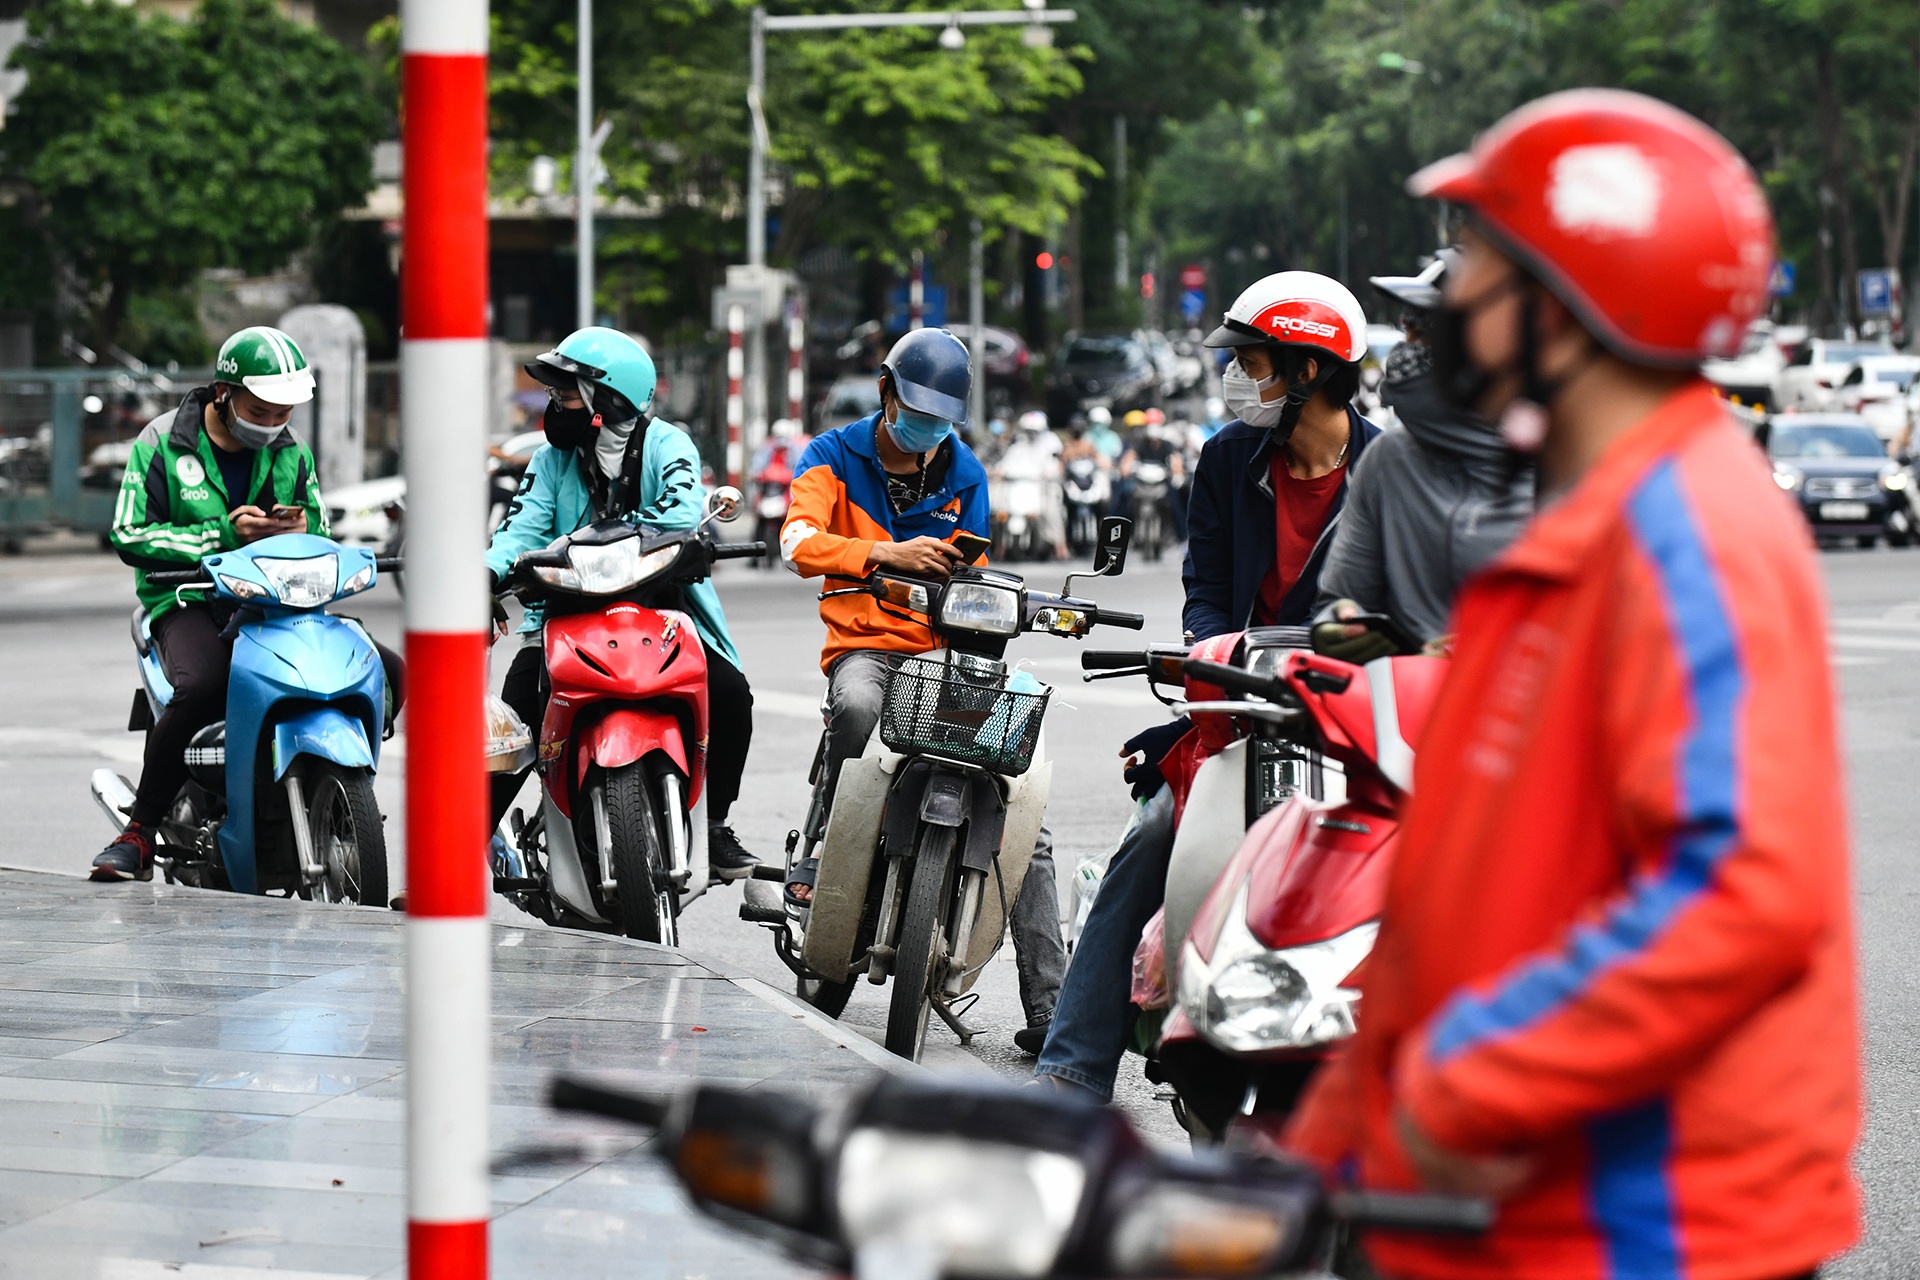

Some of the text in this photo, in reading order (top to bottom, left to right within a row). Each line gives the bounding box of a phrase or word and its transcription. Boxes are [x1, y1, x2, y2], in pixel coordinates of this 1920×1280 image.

[1272, 315, 1337, 338] ROSSI
[180, 487, 209, 501] Grab
[929, 510, 958, 523] AhaMo
[606, 606, 640, 616] HONDA
[552, 698, 570, 707] ONDA
